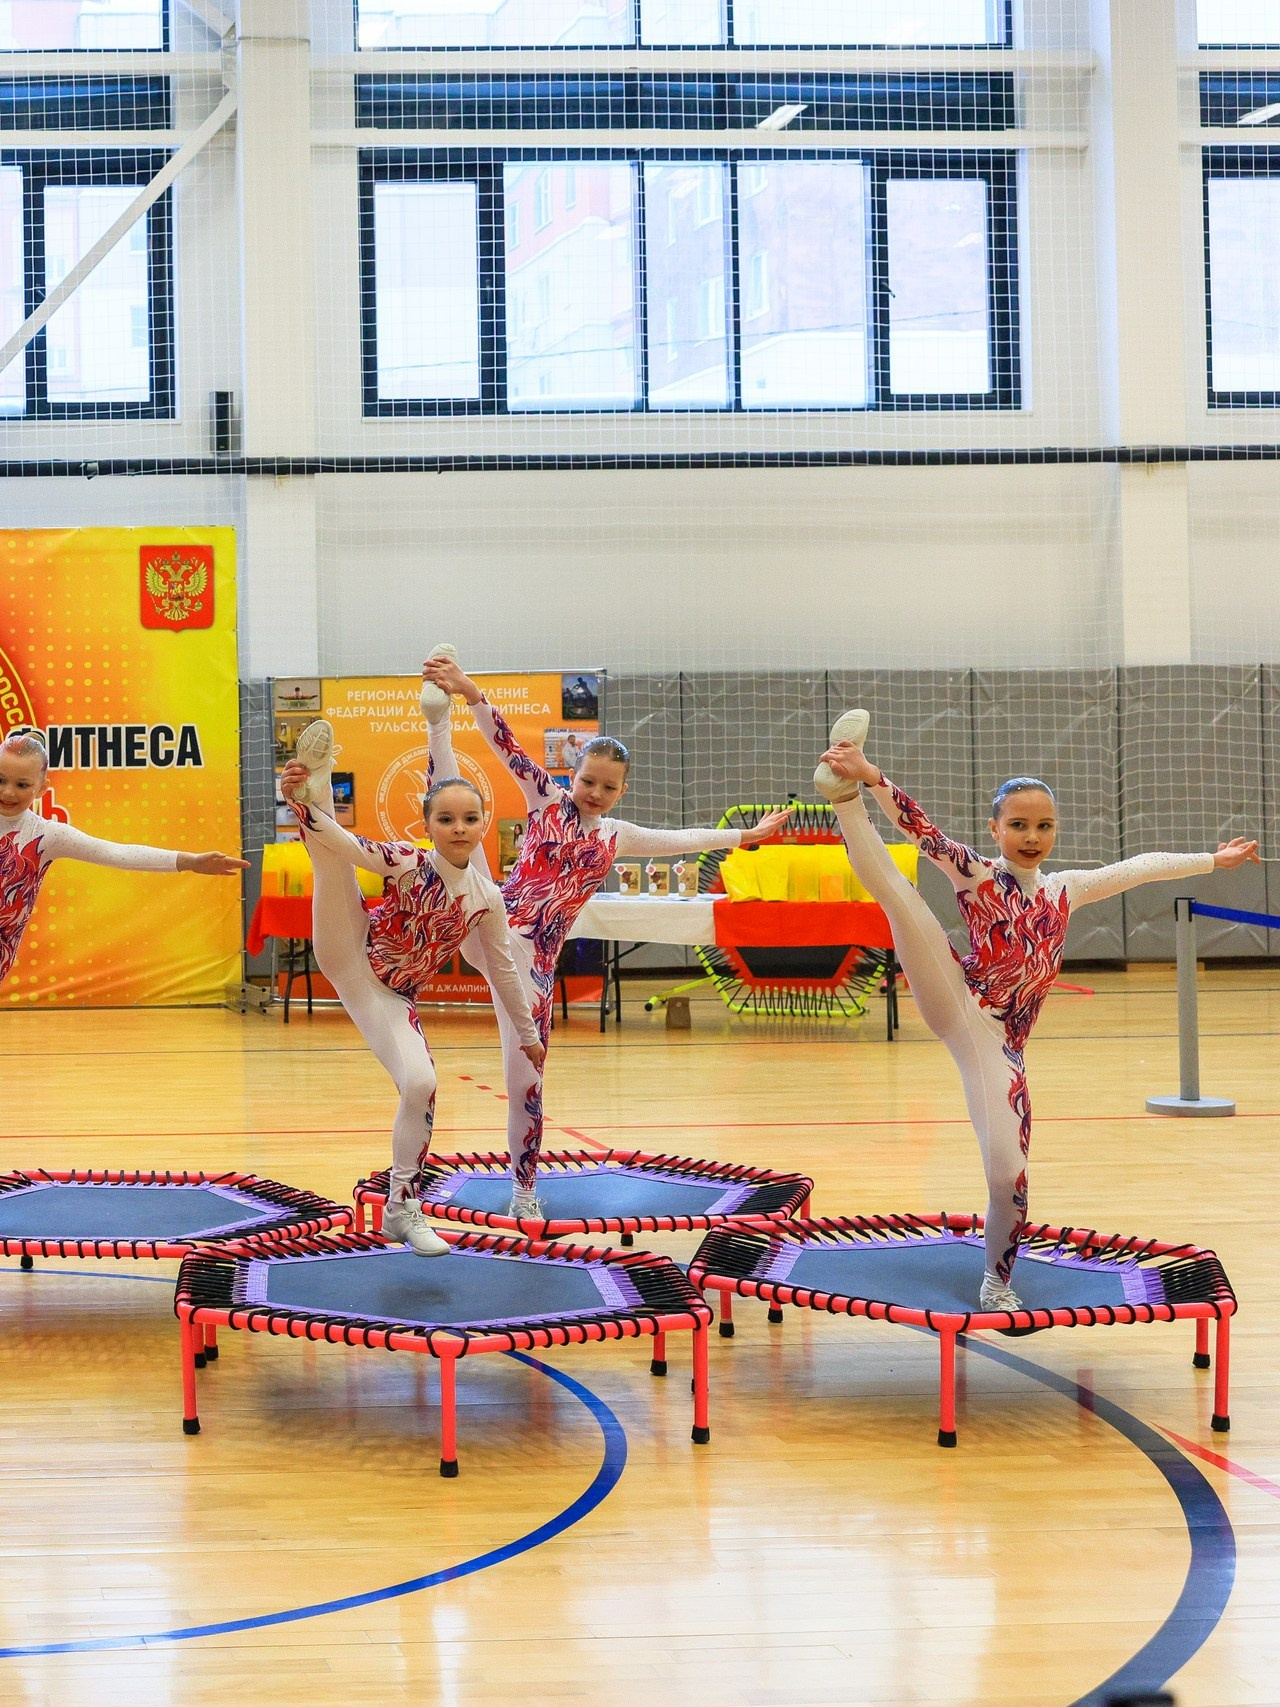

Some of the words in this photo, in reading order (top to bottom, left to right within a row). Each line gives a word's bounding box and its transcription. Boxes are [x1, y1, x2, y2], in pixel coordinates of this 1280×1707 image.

[347, 690, 421, 701] РЕГИОНАЛЬ
[326, 706, 404, 718] ФЕДЕРАЦИИ
[369, 721, 428, 732] ТУЛЬСКО
